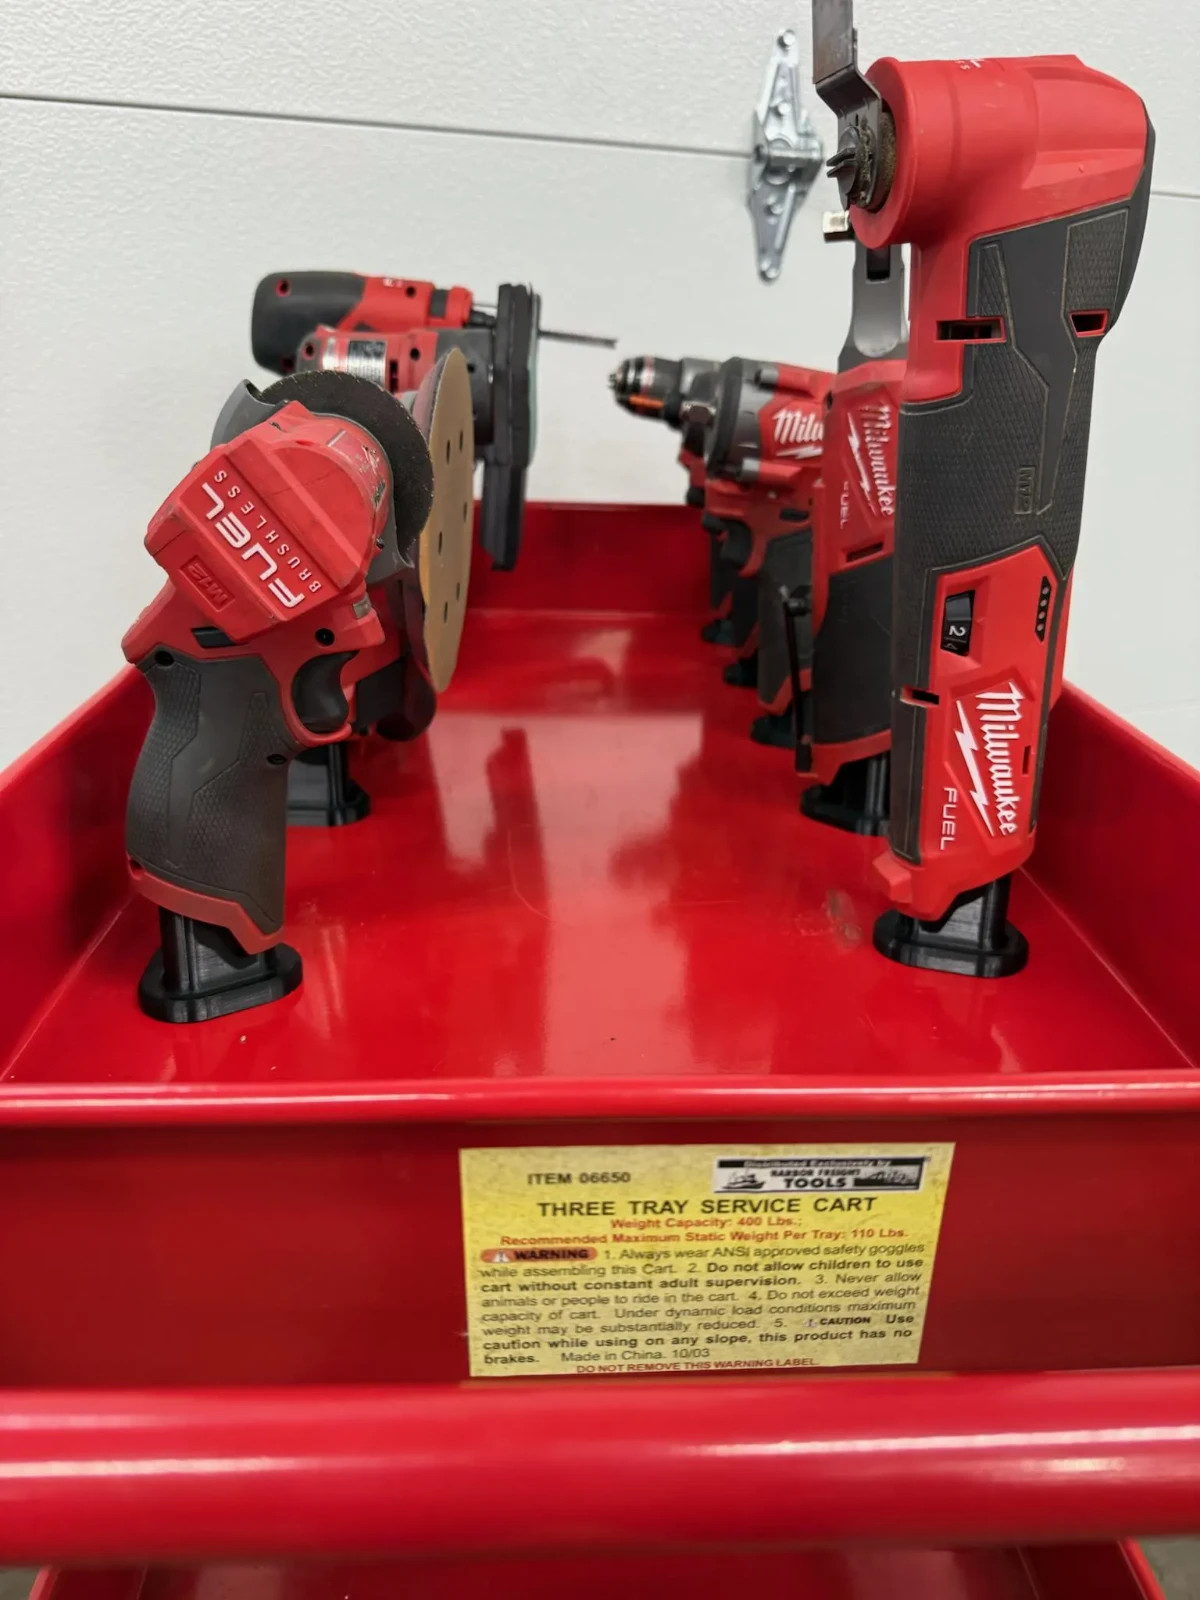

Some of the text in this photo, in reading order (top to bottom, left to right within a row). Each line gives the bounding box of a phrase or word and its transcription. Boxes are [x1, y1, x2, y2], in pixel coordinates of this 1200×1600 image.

[860, 405, 896, 517] Milwaukee
[214, 470, 321, 593] BRUSHLESS
[202, 482, 305, 608] FUEL
[188, 562, 229, 603] M12
[949, 625, 966, 637] 2
[975, 681, 1026, 836] Milwaukee
[940, 787, 958, 850] FUEL
[528, 1172, 631, 1185] ITEM 06650
[784, 1178, 847, 1188] TOOLS
[538, 1197, 877, 1216] THREE TRAY SERVICE CART
[611, 1218, 660, 1230] Weight
[665, 1216, 732, 1229] Capacity:
[738, 1217, 762, 1226] 400
[501, 1229, 908, 1245] Recommended Maximum Static Weight Per Tray: 110 Lbs.
[514, 1250, 588, 1260] WARNING
[620, 1248, 669, 1261] Always
[675, 1250, 708, 1259] wear
[713, 1247, 750, 1257] ANSI
[753, 1245, 821, 1259] approved
[823, 1244, 865, 1257] safety
[869, 1242, 924, 1257] goggles
[478, 1267, 517, 1278] while
[523, 1265, 606, 1278] assembling
[611, 1264, 637, 1274] this
[707, 1262, 728, 1272] Do
[734, 1262, 758, 1272] not
[764, 1260, 803, 1271] allow
[809, 1258, 871, 1270] children
[876, 1259, 890, 1269] to
[896, 1259, 923, 1268] use
[481, 1282, 511, 1292] cart
[519, 1281, 577, 1292] without
[584, 1279, 652, 1290] constant
[659, 1278, 698, 1288] adult
[706, 1275, 800, 1288] supervision.
[835, 1273, 878, 1284] Never
[884, 1272, 922, 1283] allow
[481, 1296, 538, 1307] animals
[543, 1297, 555, 1306] or
[561, 1294, 609, 1307] people
[615, 1294, 628, 1304] to
[632, 1293, 659, 1304] ride
[664, 1292, 676, 1303] in
[682, 1291, 704, 1302] the
[767, 1290, 787, 1300] Do
[792, 1289, 815, 1299] not
[819, 1287, 869, 1298] exceed
[874, 1286, 920, 1298] weight
[481, 1309, 541, 1323] capacity
[550, 1308, 562, 1319] of
[614, 1307, 660, 1319] Under
[665, 1305, 725, 1318] dynamic
[732, 1304, 762, 1315] load
[769, 1303, 840, 1314] conditions
[848, 1300, 916, 1311] maximum
[483, 1325, 530, 1337] weight
[537, 1325, 567, 1336] may
[575, 1323, 593, 1334] be
[600, 1321, 691, 1334] substantially
[697, 1318, 759, 1330] reduced.
[820, 1316, 871, 1325] CAUTION
[886, 1314, 914, 1324] Use
[483, 1328, 912, 1350] caution while using on any slope, this product has no
[484, 1348, 709, 1364] brakes. Made in China. 10/03
[577, 1365, 596, 1373] DO
[627, 1362, 680, 1372] REMOVE
[685, 1361, 712, 1369] THIS
[714, 1359, 773, 1368] WARNING
